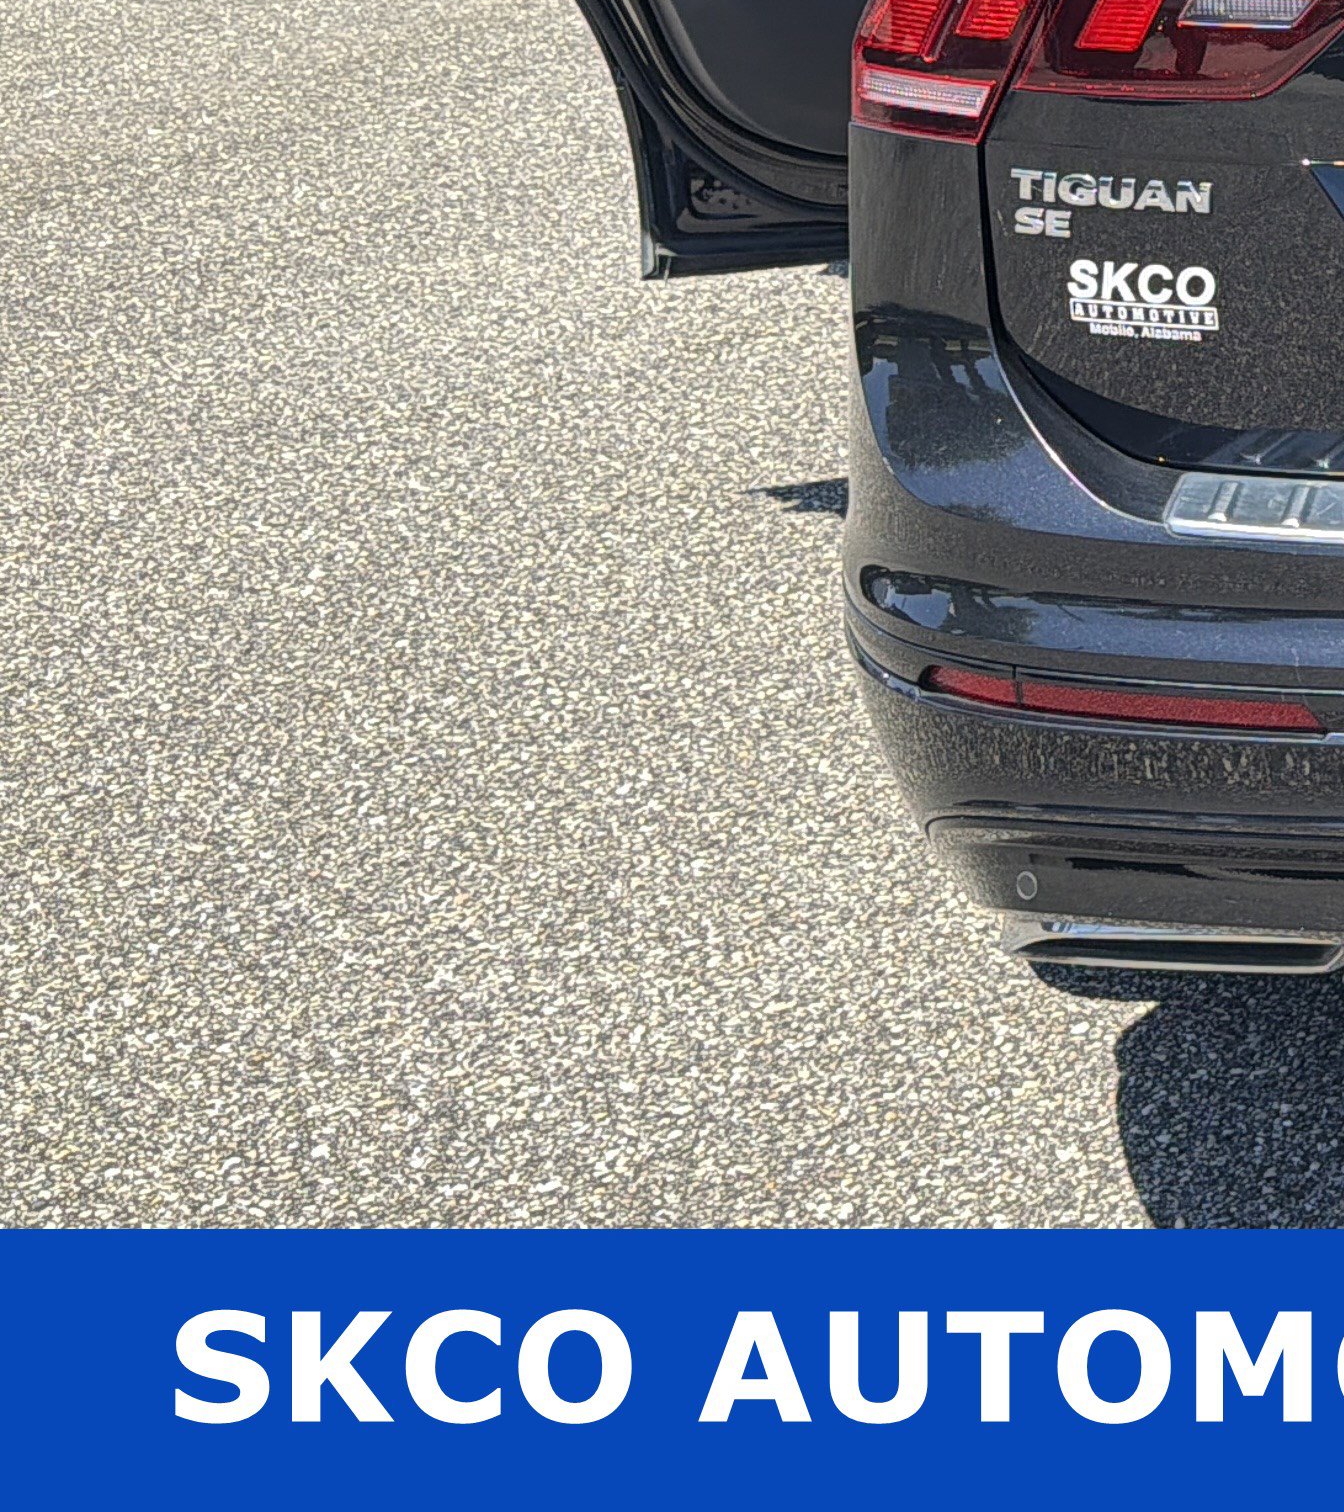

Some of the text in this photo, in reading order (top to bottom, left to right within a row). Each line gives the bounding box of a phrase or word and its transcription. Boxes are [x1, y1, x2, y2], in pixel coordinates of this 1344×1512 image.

[1010, 168, 1213, 214] TIGUAN
[1014, 206, 1072, 238] SE
[1067, 259, 1216, 307] SKCO
[1074, 302, 1215, 326] AUTOMOTIVE
